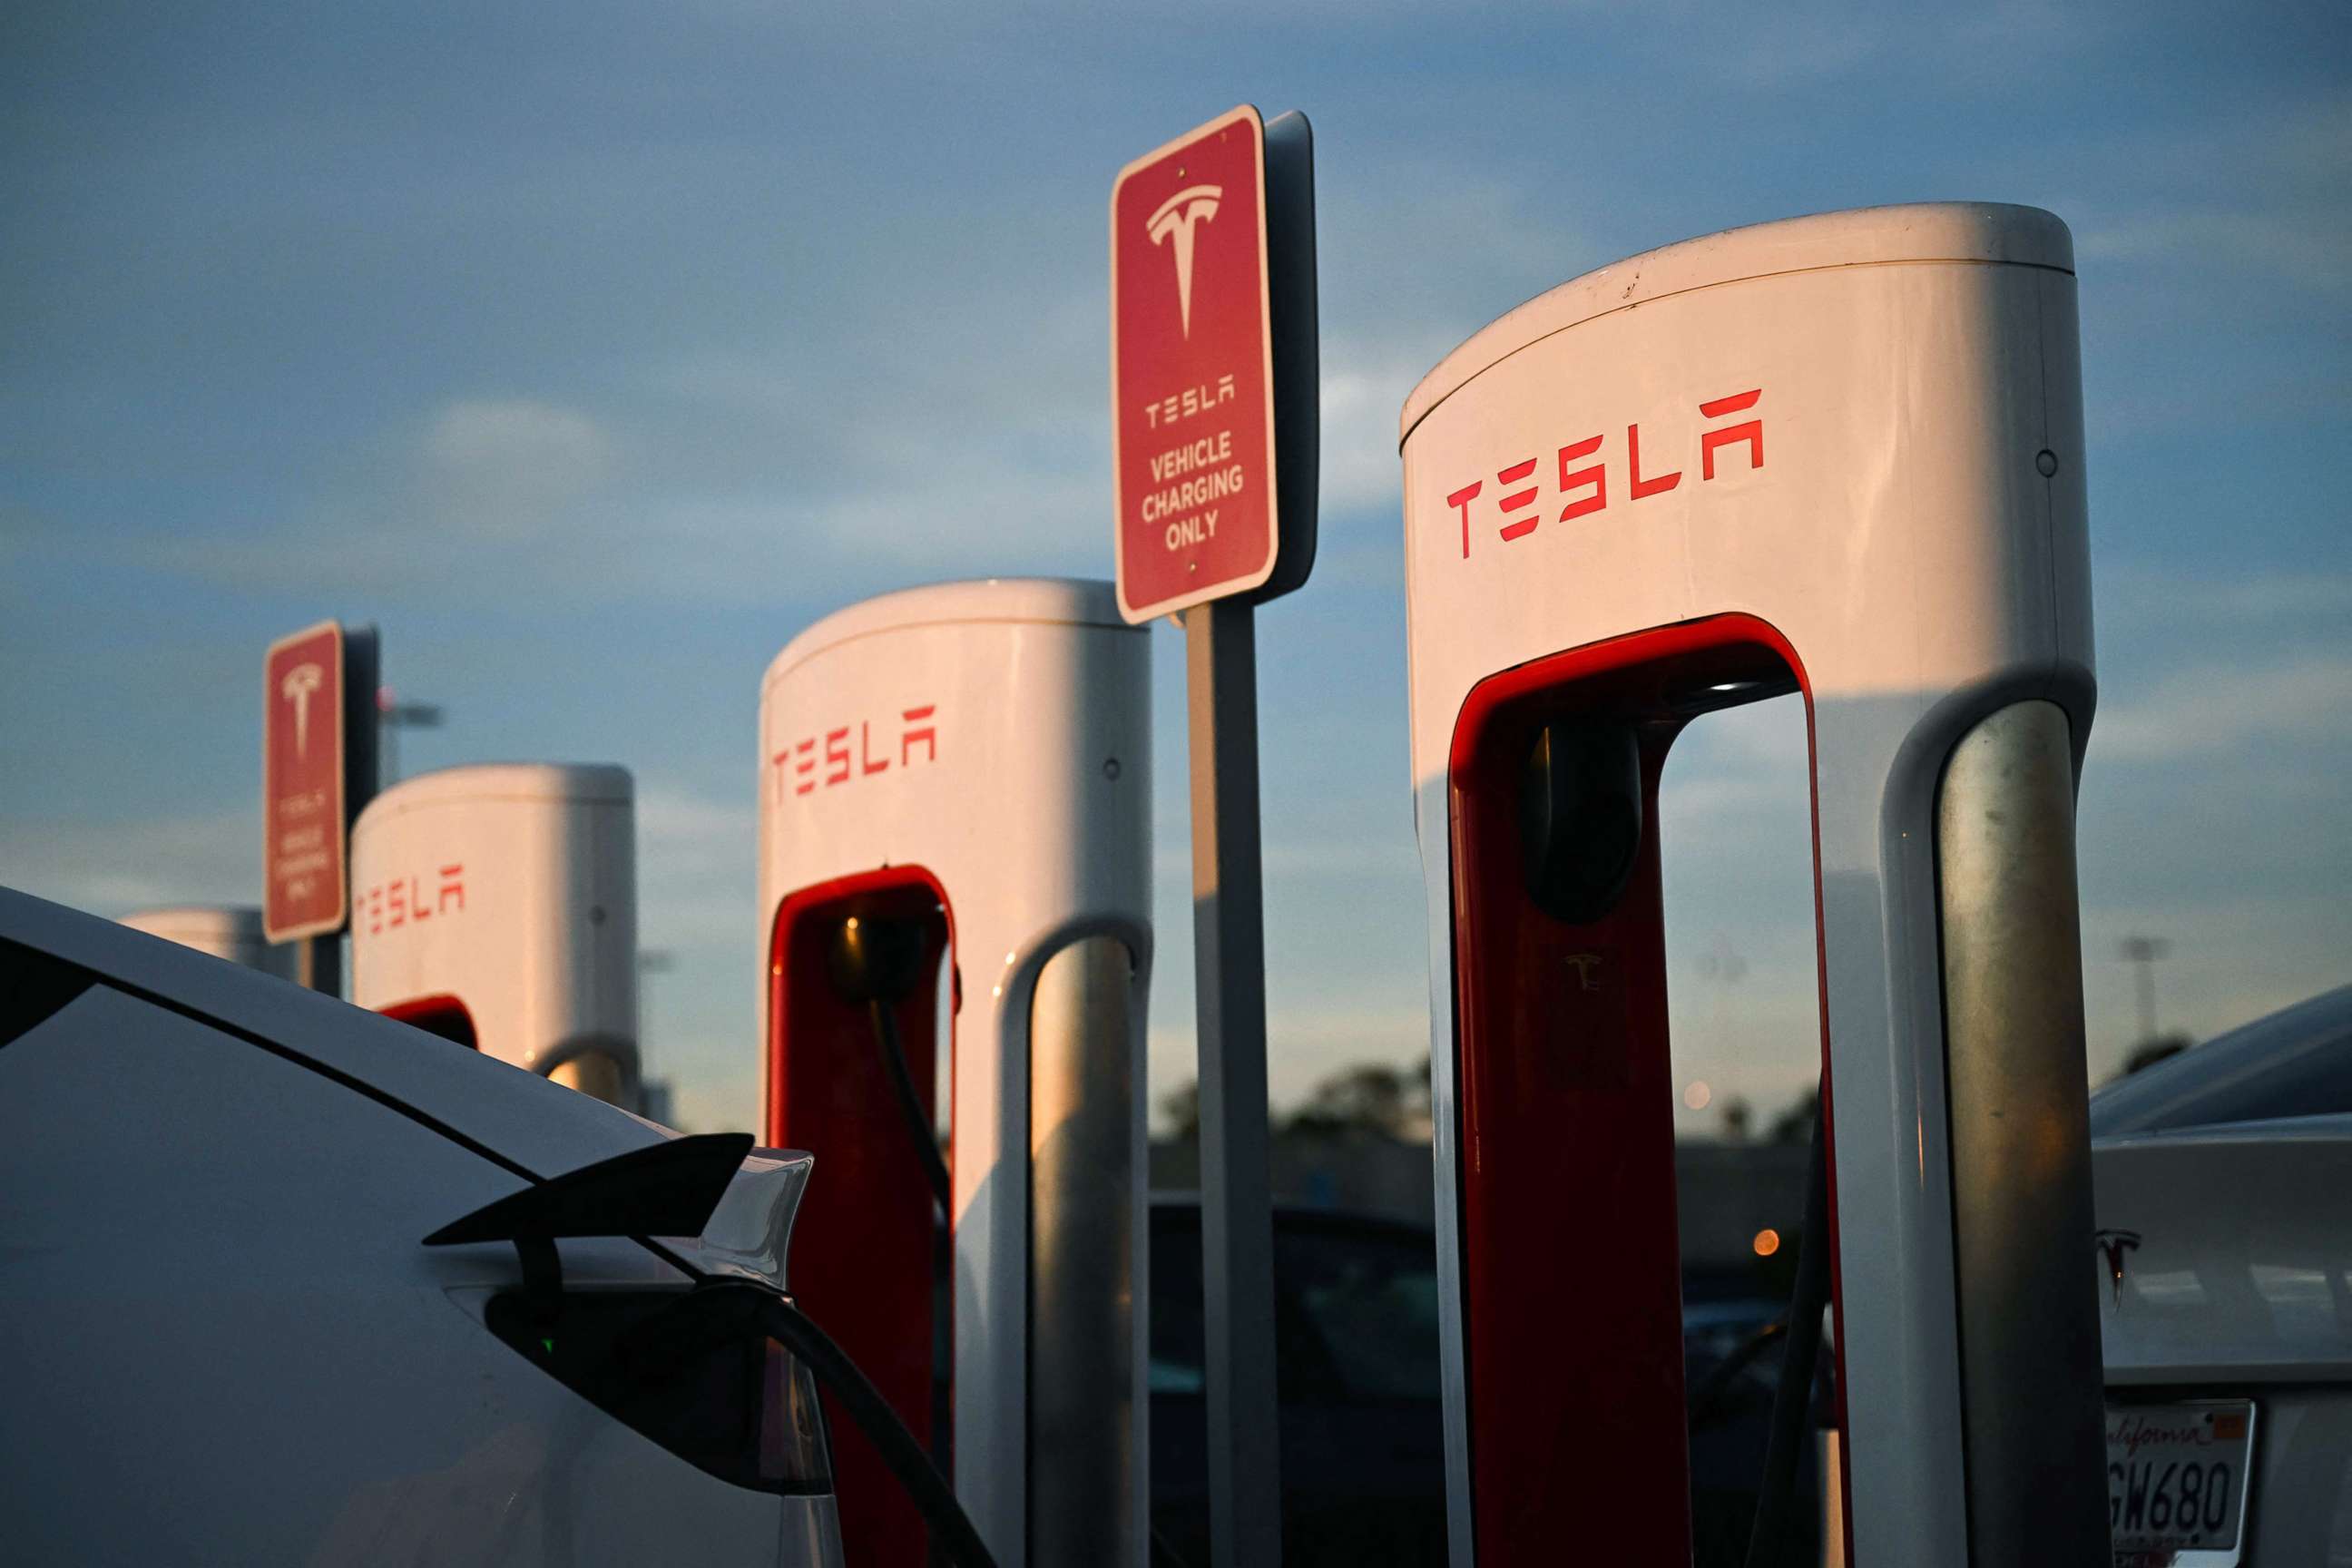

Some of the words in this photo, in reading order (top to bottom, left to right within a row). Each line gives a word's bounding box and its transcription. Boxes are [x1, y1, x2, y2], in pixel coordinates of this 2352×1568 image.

[1144, 374, 1235, 429] TESLA
[1151, 430, 1231, 483] VEHICLE
[1446, 388, 1763, 559] TESLA
[1142, 465, 1243, 524] CHARGING
[1165, 509, 1219, 552] ONLY
[772, 704, 936, 806] TESLA
[2109, 1462, 2230, 1532] GW680
